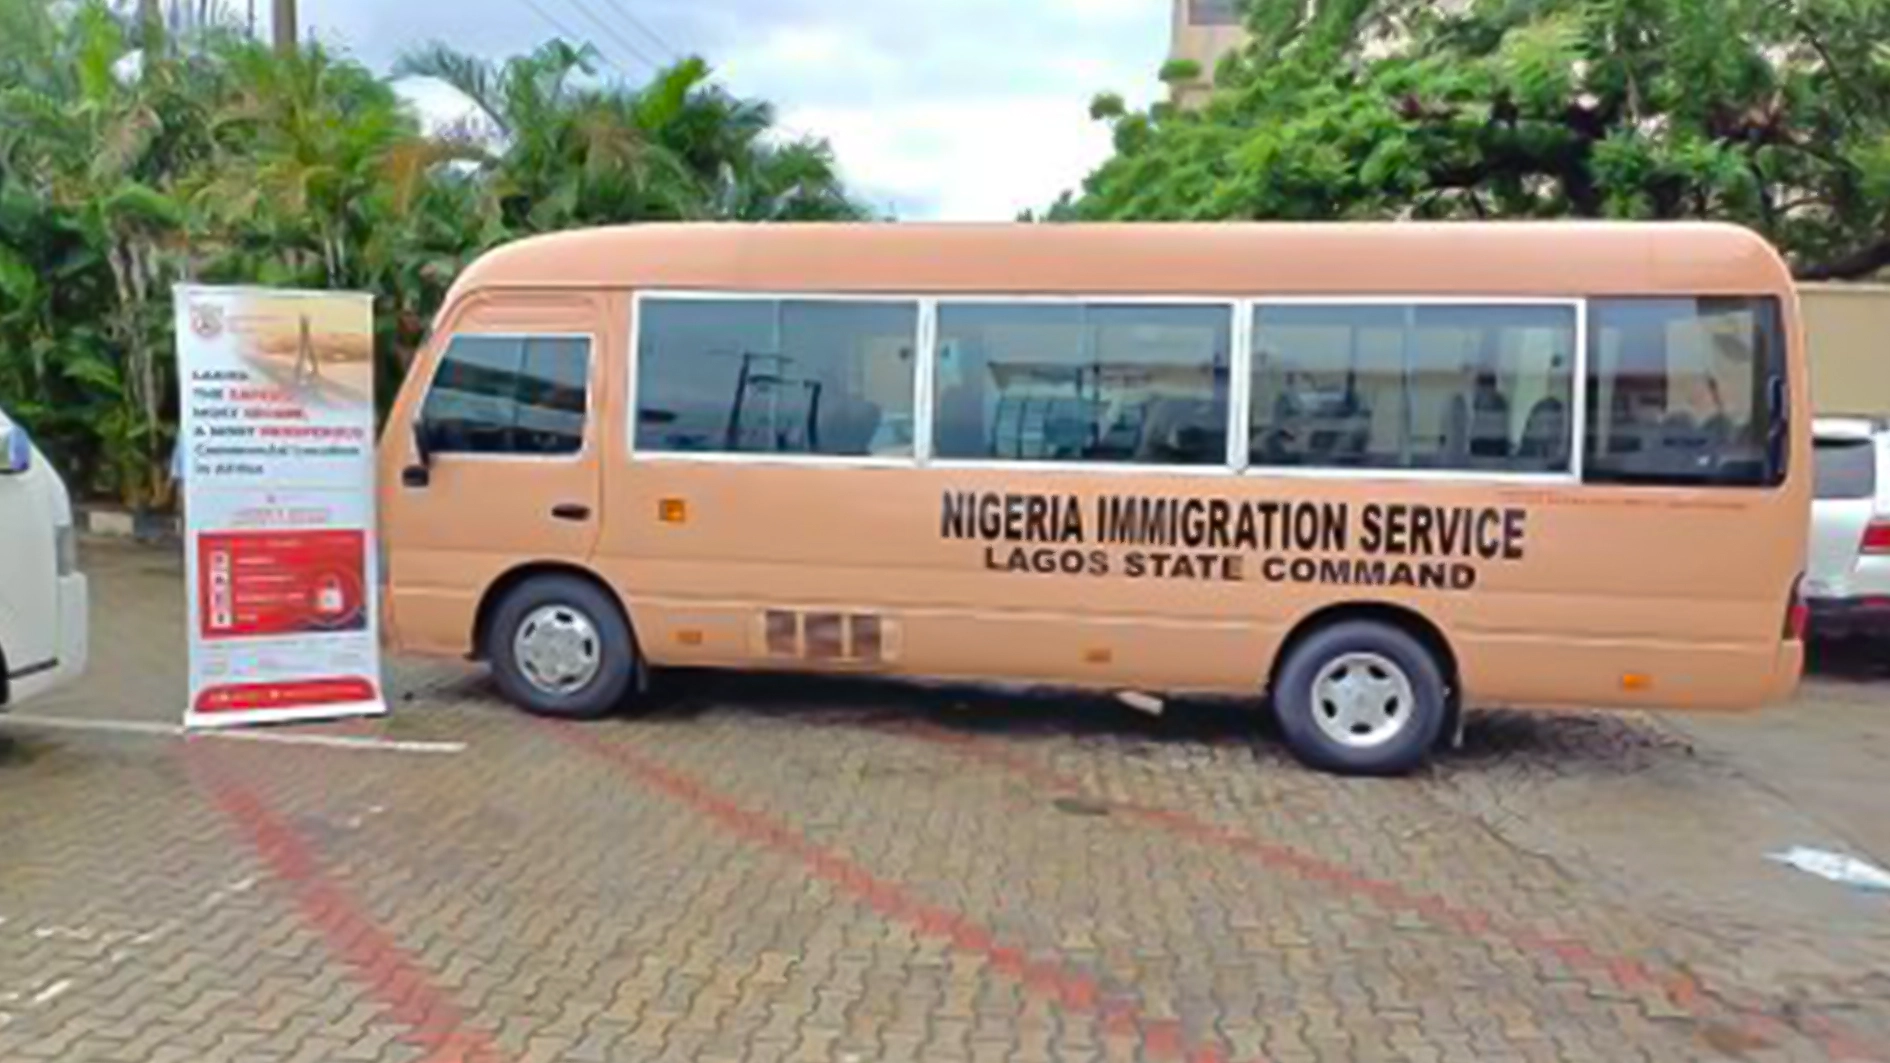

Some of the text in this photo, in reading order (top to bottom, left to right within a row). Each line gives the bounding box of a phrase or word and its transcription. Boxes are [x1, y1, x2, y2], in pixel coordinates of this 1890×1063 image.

[940, 490, 1526, 560] NIGERIA IMMIGRATION SERVICE
[985, 546, 1477, 590] LAGOS STATE COMMAND
